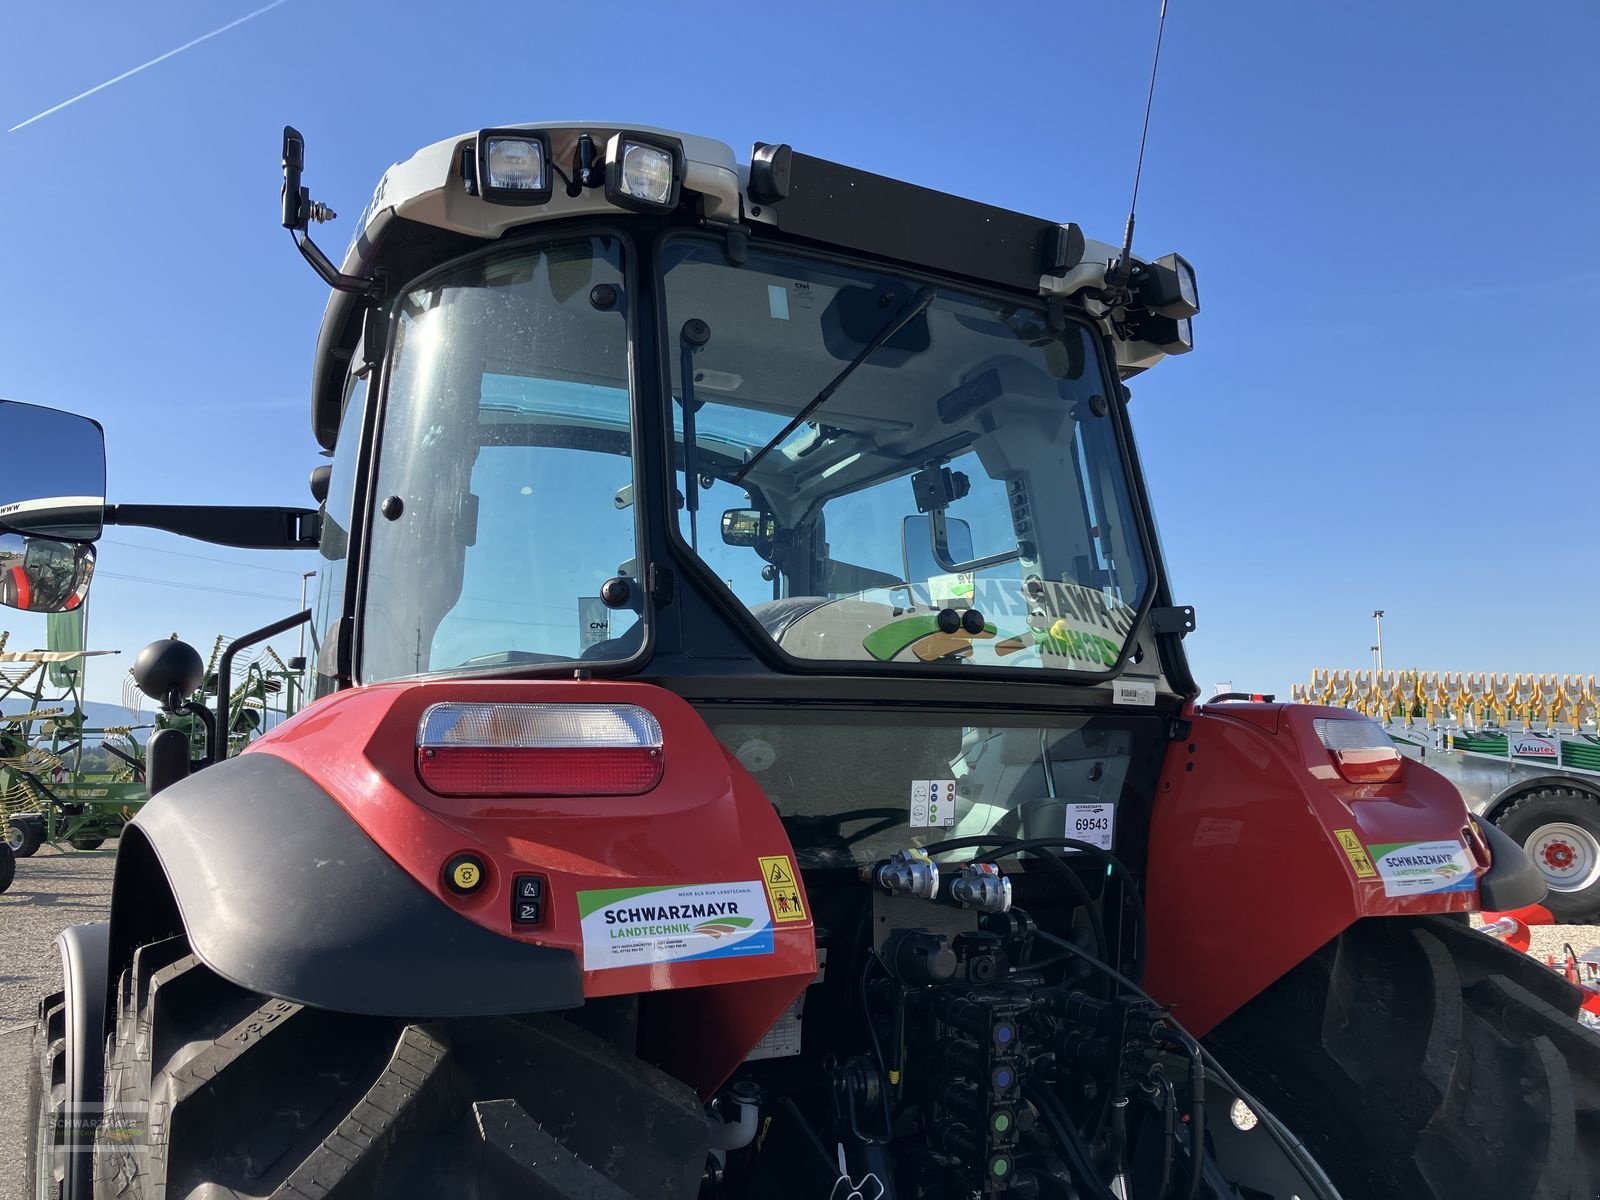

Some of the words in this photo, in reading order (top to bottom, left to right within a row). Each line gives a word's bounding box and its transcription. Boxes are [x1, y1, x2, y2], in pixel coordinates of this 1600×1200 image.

[1513, 743, 1556, 754] Vakutec
[1075, 818, 1108, 831] 69543
[1385, 853, 1454, 868] SCHWARZMAYR
[604, 901, 739, 925] SCHWARZMAYR
[609, 923, 691, 939] LANDTECHNIK
